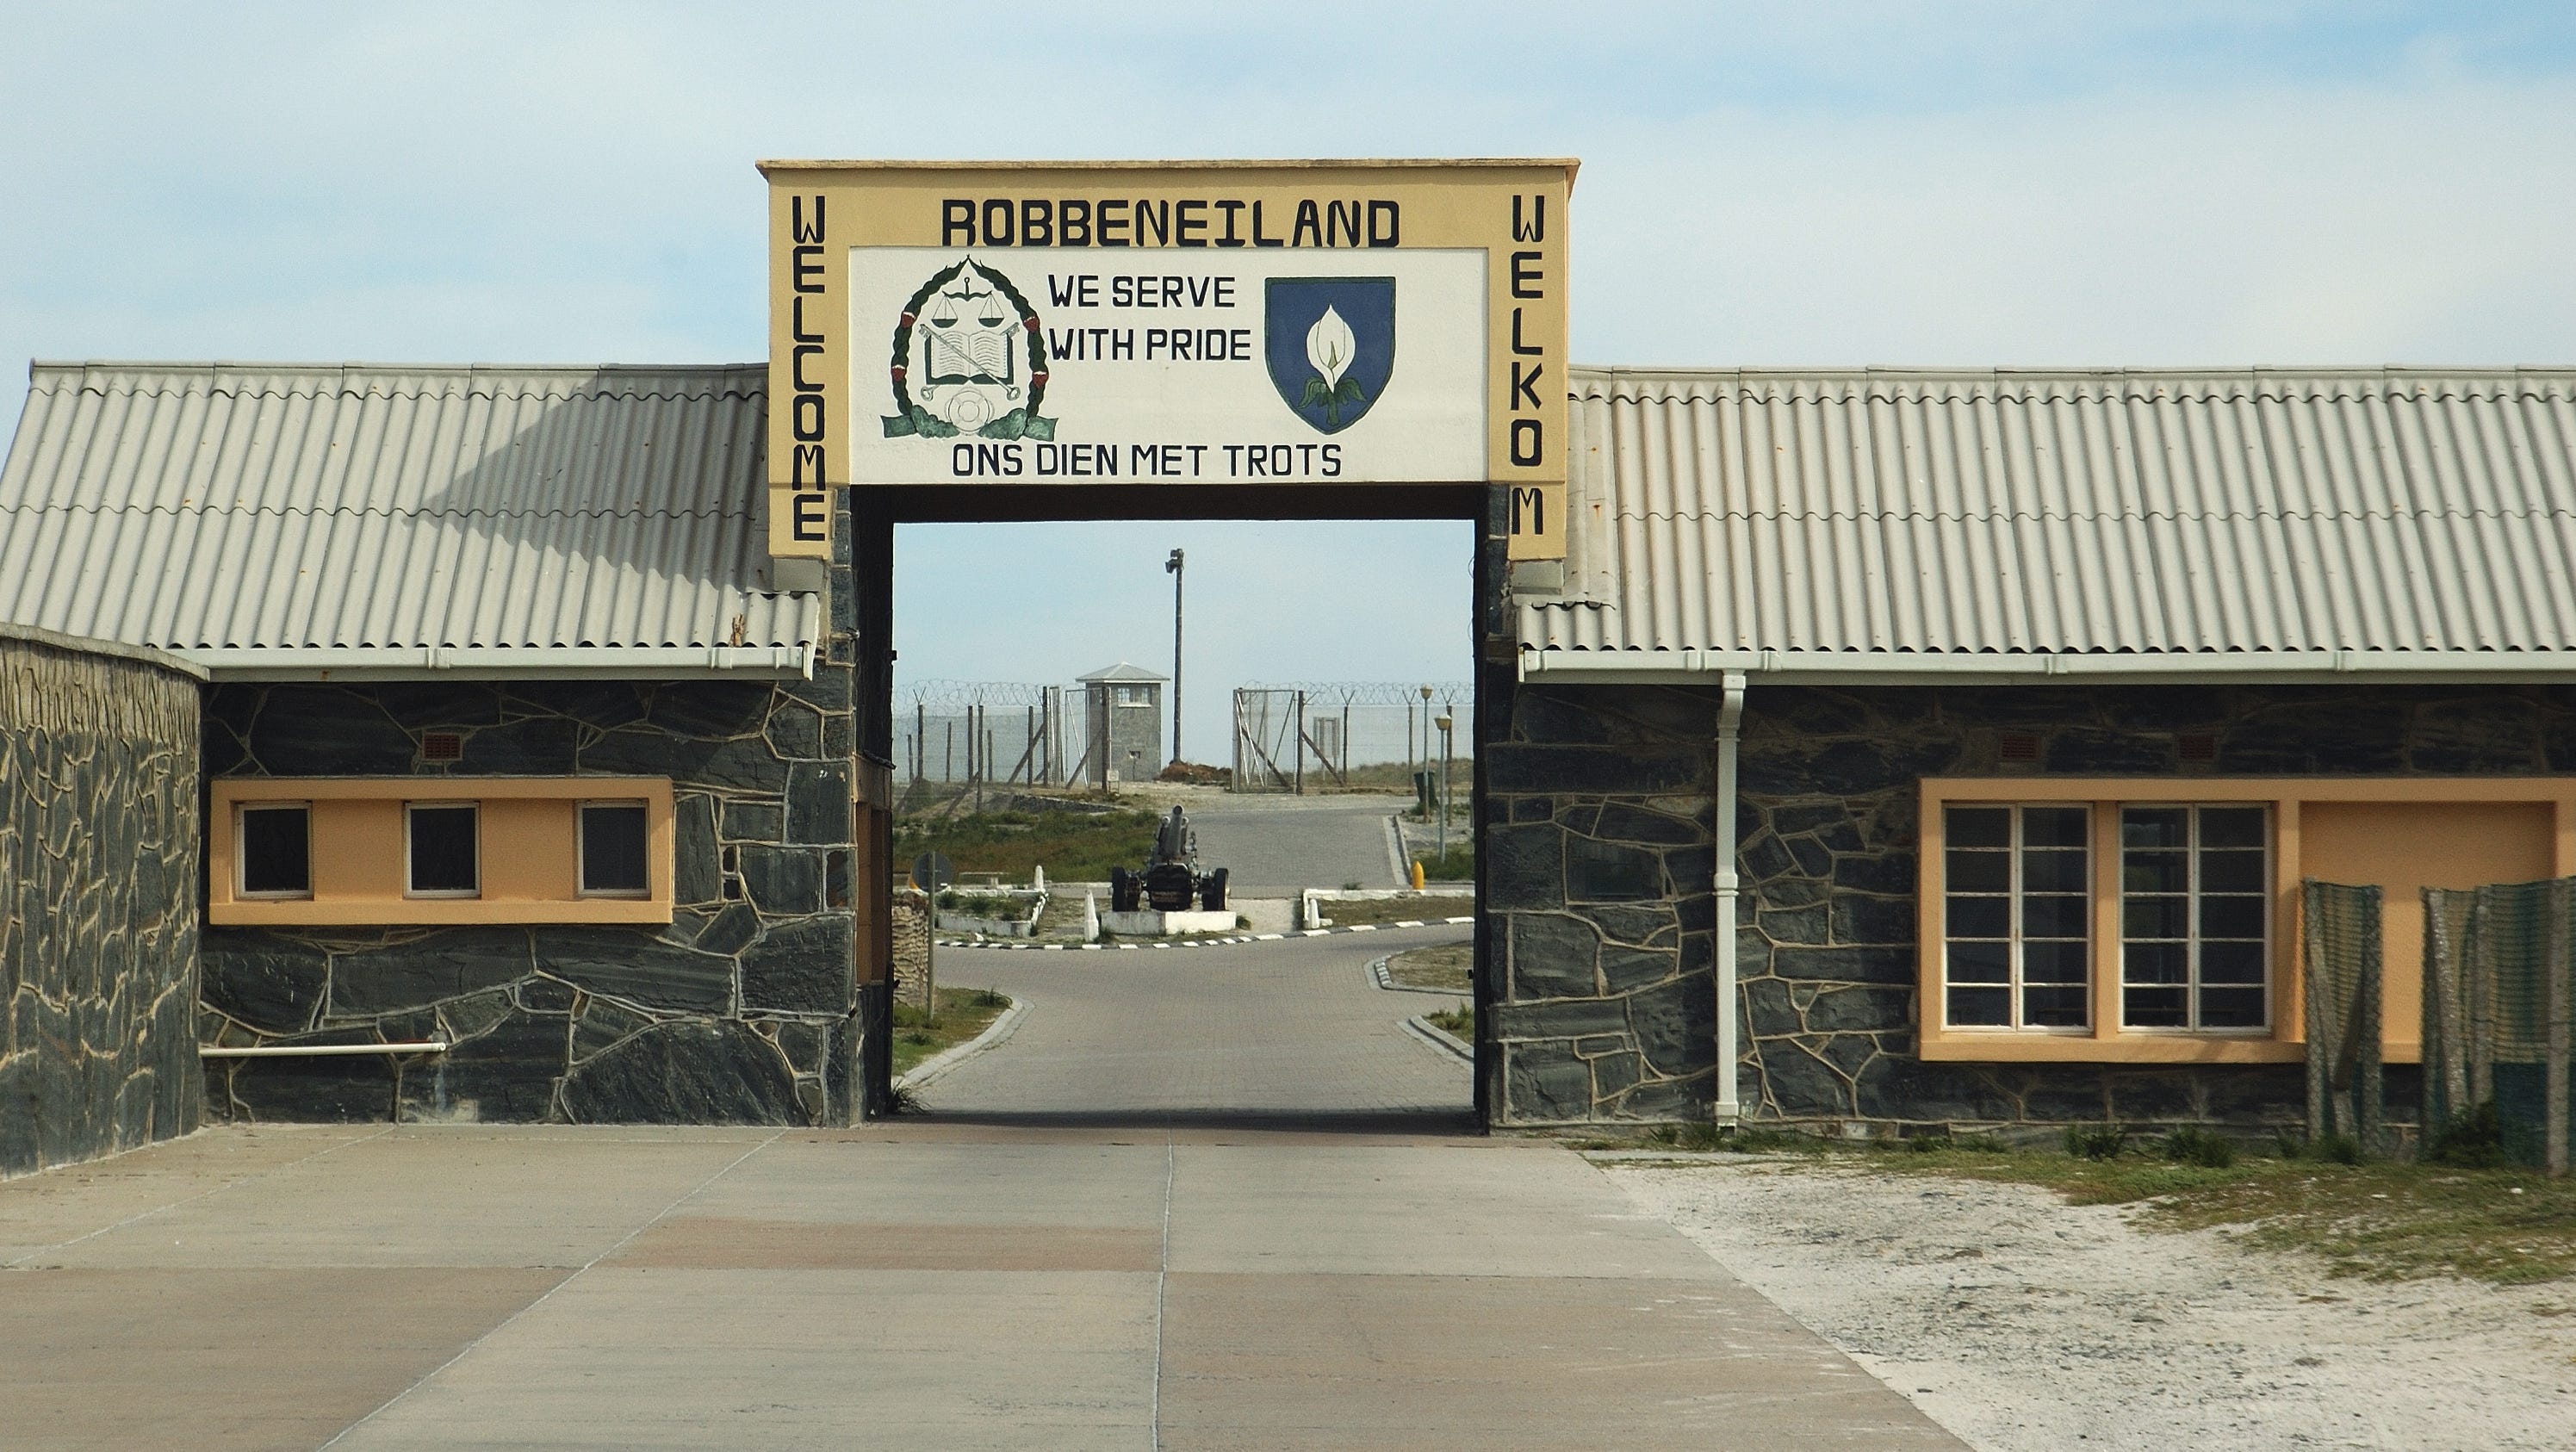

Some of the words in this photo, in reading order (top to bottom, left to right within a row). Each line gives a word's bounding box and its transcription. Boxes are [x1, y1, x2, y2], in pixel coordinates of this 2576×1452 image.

[941, 199, 1400, 247] ROBBENEILAND
[1047, 274, 1099, 307] WE
[1112, 276, 1235, 307] SERVE
[1048, 328, 1134, 361] WITH
[1146, 328, 1251, 361] PRIDE
[791, 195, 826, 542] WELCOME
[1510, 195, 1545, 536] WELKOM
[953, 444, 1023, 476] ONS
[1036, 444, 1118, 476] DIEN
[1132, 444, 1208, 476] MET
[1222, 444, 1342, 477] TROTS
